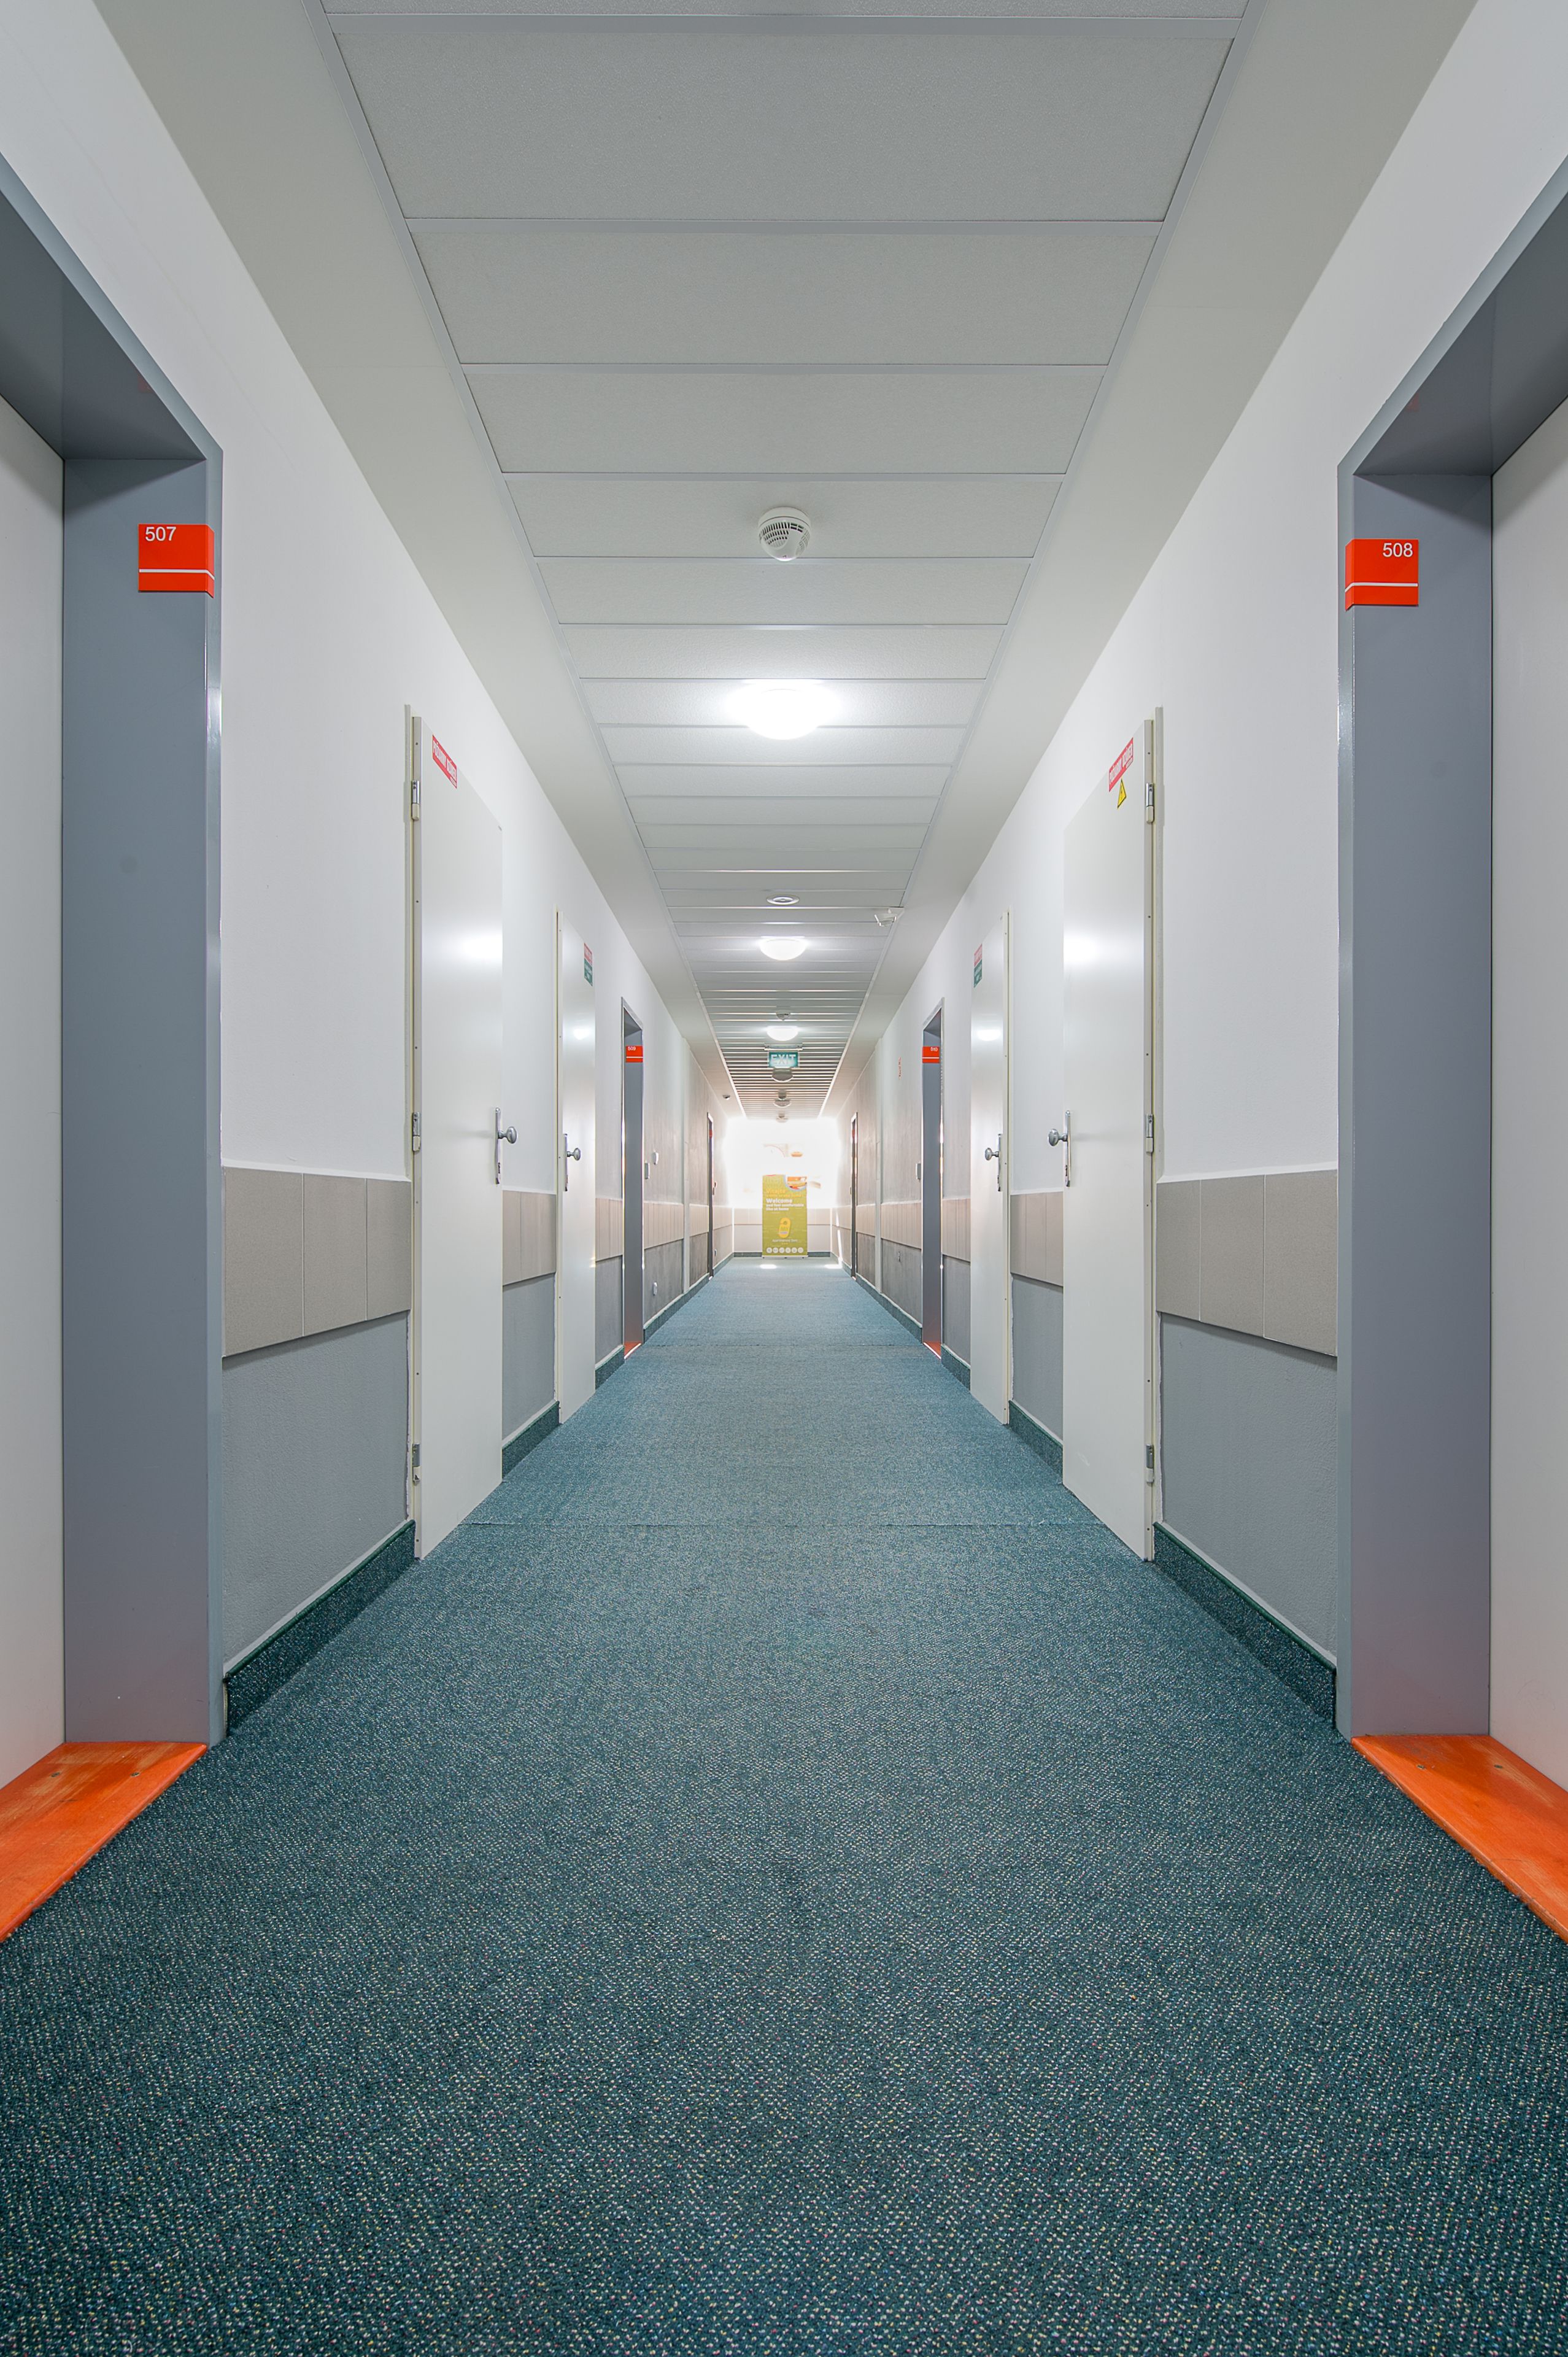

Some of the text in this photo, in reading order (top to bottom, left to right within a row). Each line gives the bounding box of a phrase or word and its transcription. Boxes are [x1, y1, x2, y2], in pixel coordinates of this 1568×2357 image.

[145, 526, 177, 541] 507
[1382, 542, 1413, 557] 508
[771, 1054, 796, 1064] EXIT
